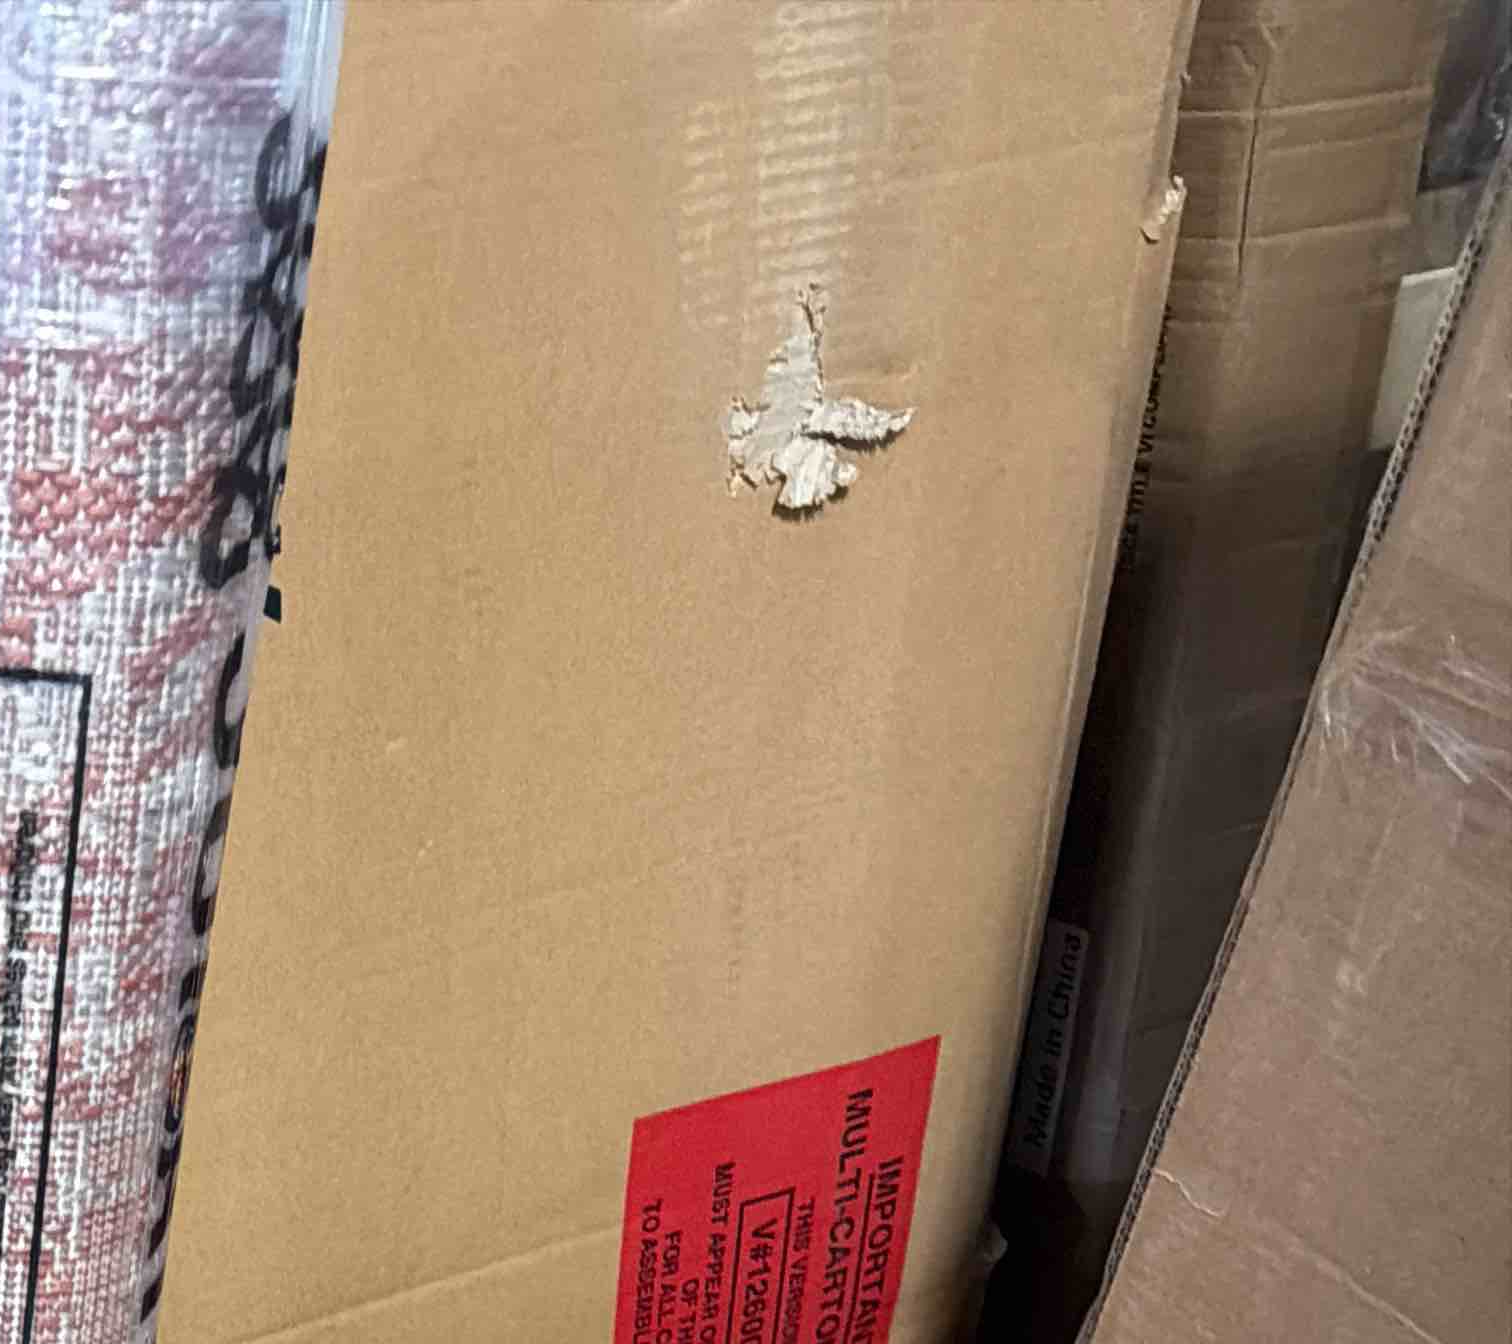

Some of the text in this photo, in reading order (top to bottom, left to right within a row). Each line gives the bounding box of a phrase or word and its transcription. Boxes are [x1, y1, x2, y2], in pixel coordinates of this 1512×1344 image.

[641, 1197, 664, 1233] TO
[711, 1161, 736, 1227] MUST
[792, 1195, 814, 1253] THIS
[661, 1229, 684, 1279] FOR
[700, 1232, 727, 1319] APPEAR
[656, 1283, 677, 1328] ALL
[679, 1278, 700, 1308] OF
